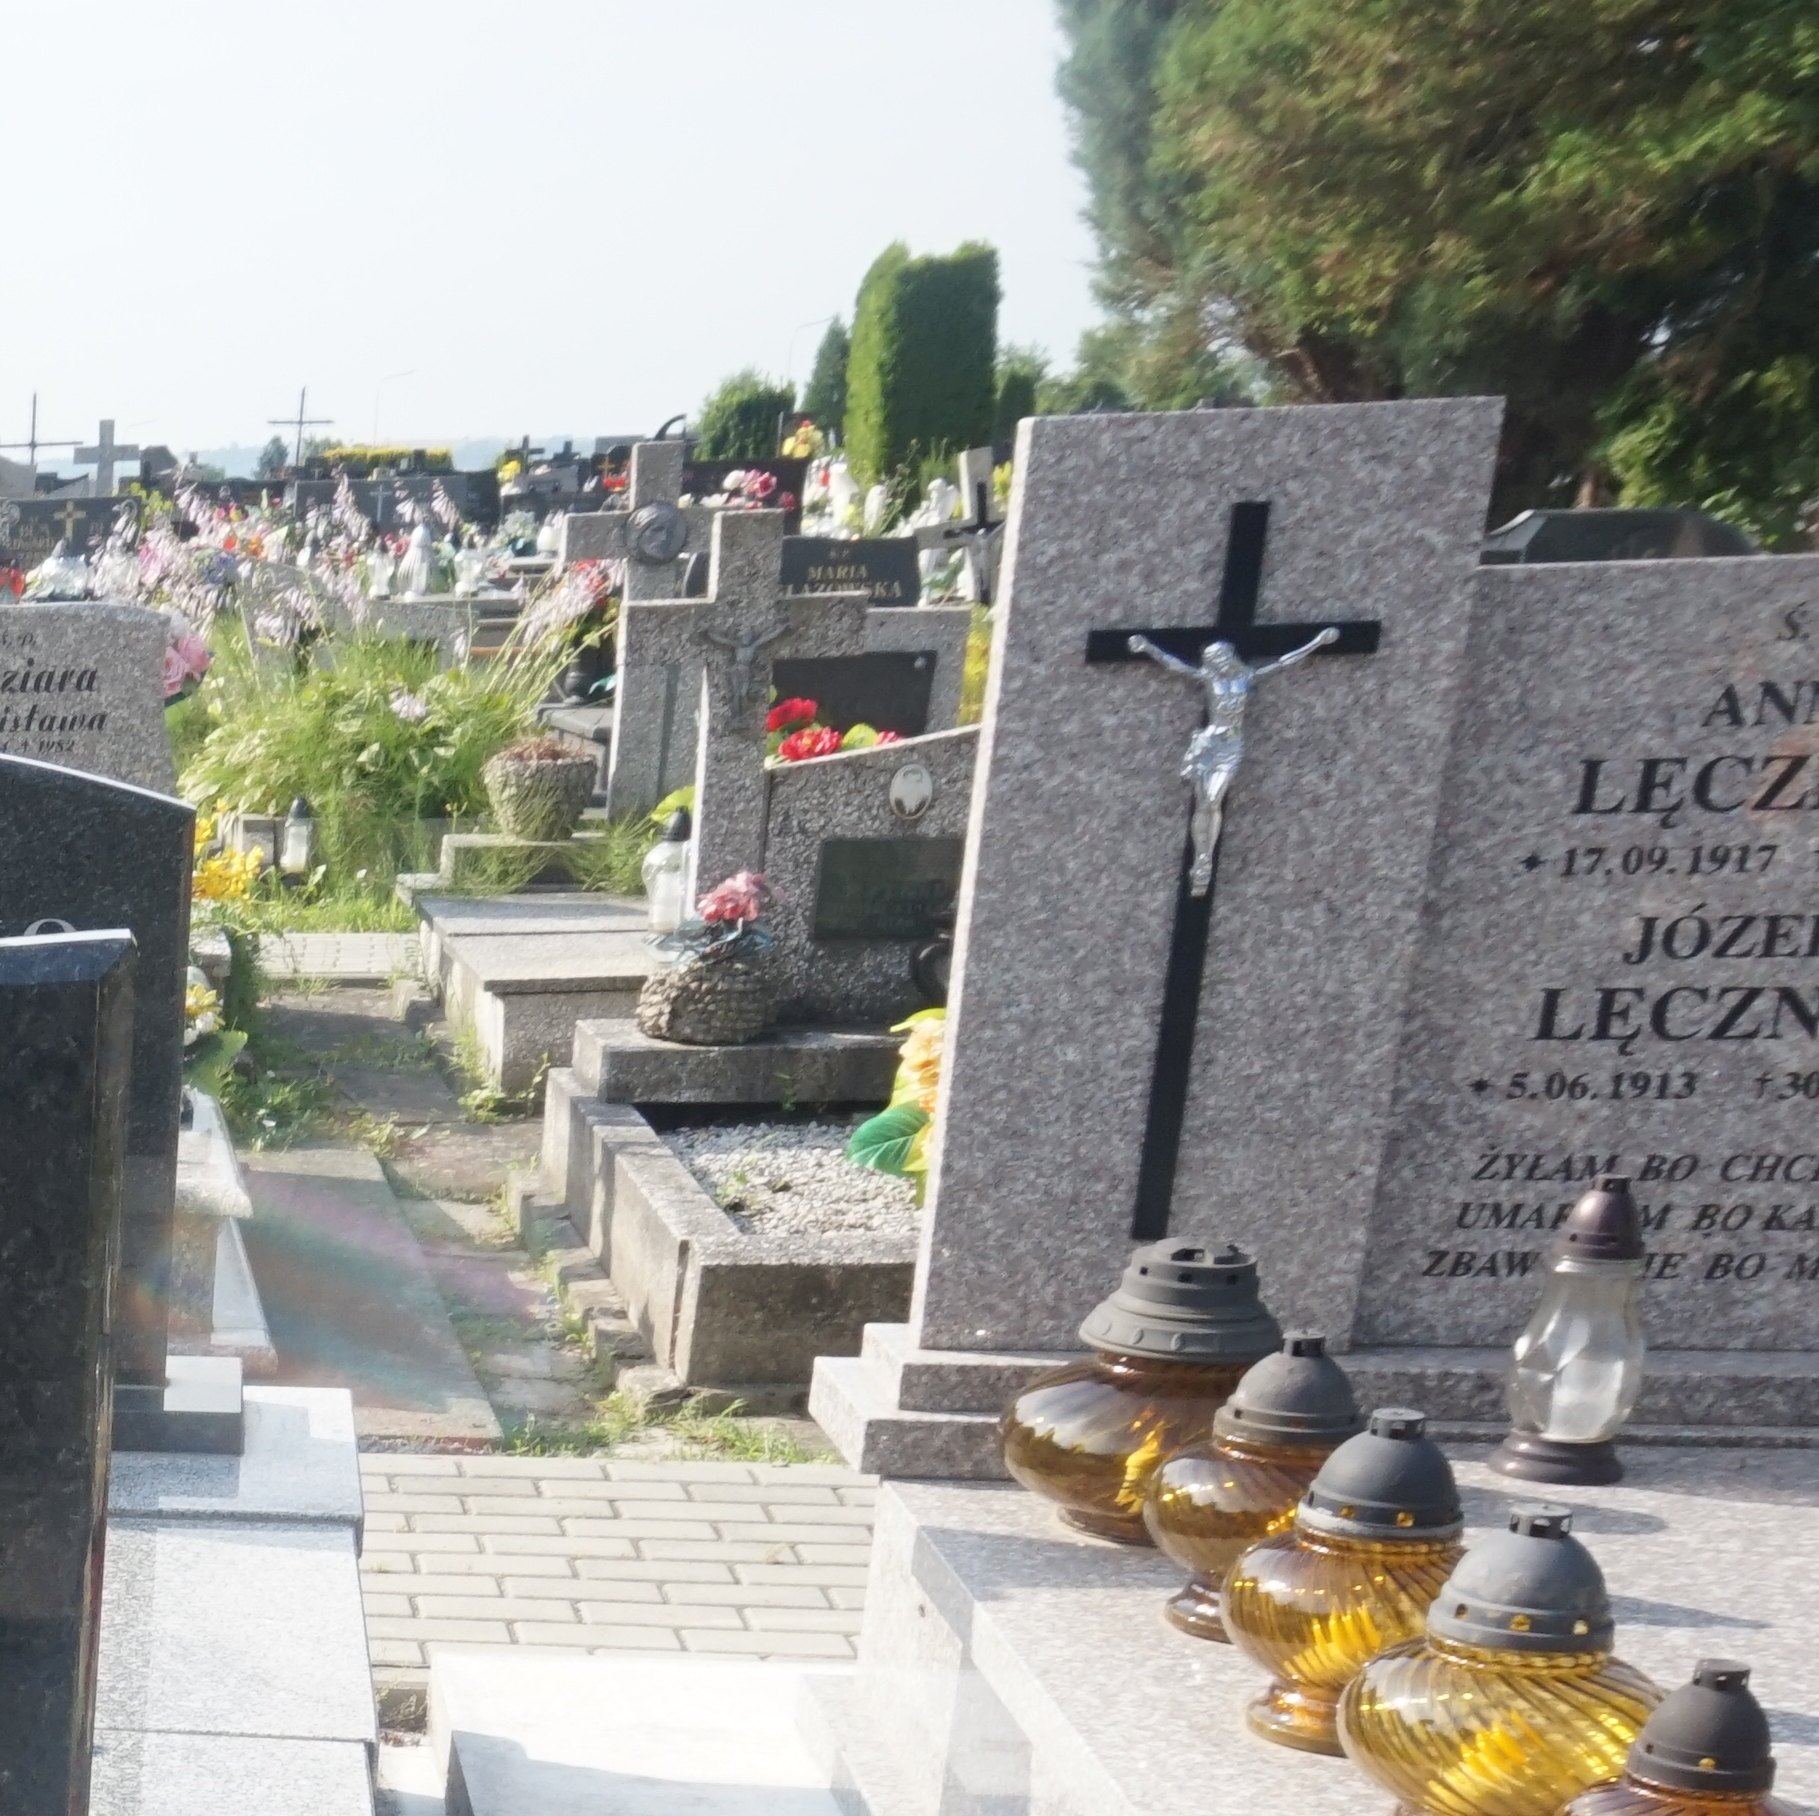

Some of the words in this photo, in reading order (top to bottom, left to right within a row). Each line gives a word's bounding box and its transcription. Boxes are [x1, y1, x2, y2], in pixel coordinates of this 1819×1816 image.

[807, 563, 869, 581] MARIA
[1571, 753, 1819, 830] LĘCZ
[1636, 1153, 1700, 1182] BO
[1688, 1203, 1755, 1232] BO
[1702, 1252, 1766, 1281] BO
